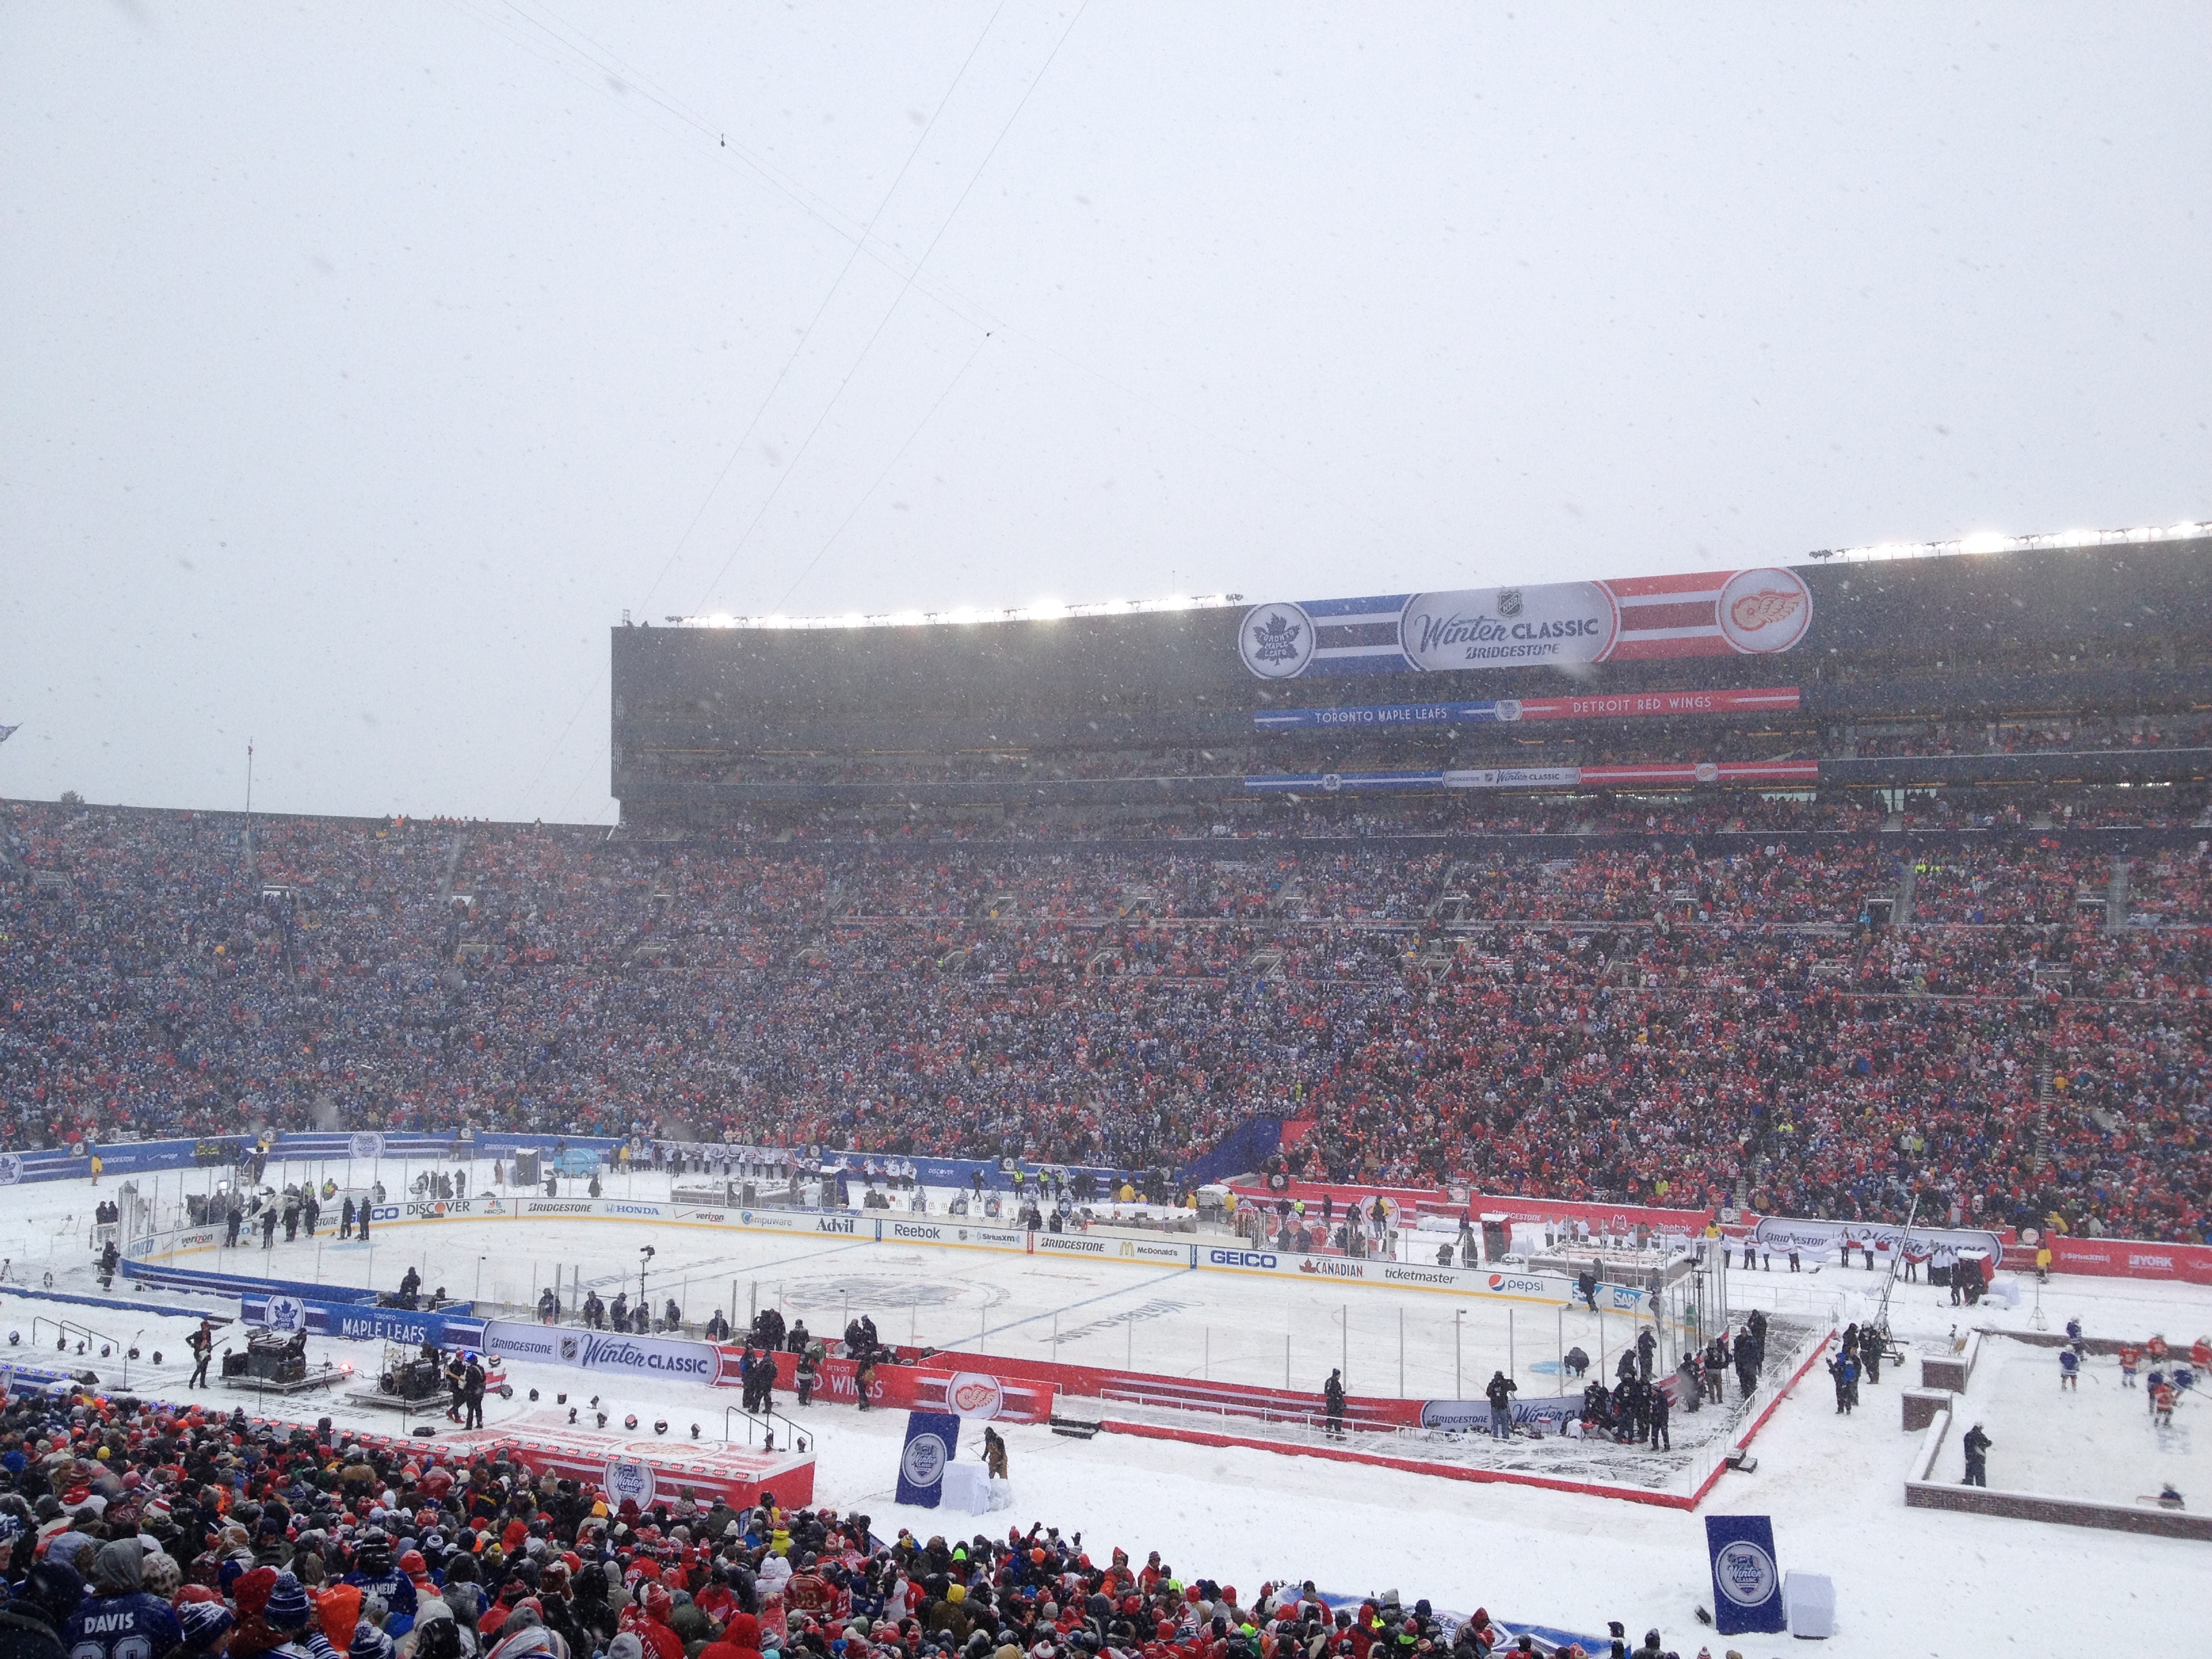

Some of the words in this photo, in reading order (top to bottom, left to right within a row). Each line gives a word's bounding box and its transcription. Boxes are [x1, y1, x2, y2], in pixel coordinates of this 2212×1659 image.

[1260, 630, 1294, 642] TORONTO
[1414, 612, 1510, 653] Winter
[1511, 619, 1599, 639] CLASSIC
[1265, 641, 1288, 649] MAPLE
[1465, 644, 1559, 659] BRIDGESTONE
[1265, 649, 1287, 657] LEAFS
[1574, 699, 1630, 712] DETROIT
[1638, 699, 1660, 710] RED
[1669, 696, 1712, 708] WINGS
[1315, 711, 1373, 723] TORONTO
[1378, 709, 1410, 721] MAPLE
[1416, 708, 1447, 719] LEAFS
[1496, 770, 1527, 784] Winter
[407, 1201, 470, 1215] DISCOVER
[528, 1203, 592, 1212] BRIDGESTONE
[616, 1205, 660, 1215] HONDA
[696, 1212, 724, 1223] verizon
[816, 1217, 855, 1233] Advil
[182, 1233, 213, 1244] verizon
[895, 1223, 941, 1240] Reebok
[1041, 1237, 1105, 1252] BRIDGESTONE
[1137, 1246, 1178, 1256] McDonald's
[1210, 1250, 1277, 1269] GEICO
[2139, 1256, 2173, 1267] YORK
[1316, 1261, 1363, 1277] CANADIAN
[1385, 1267, 1455, 1284] ticketmaster
[1508, 1279, 1543, 1292] pepsi
[1614, 1292, 1635, 1307] SAP
[343, 1318, 382, 1338] MAPLE
[388, 1323, 425, 1343] LEAFS
[491, 1337, 552, 1354] BRIDGESTONE
[581, 1333, 646, 1367] Winter
[647, 1354, 708, 1374] CLASSIC
[827, 1365, 850, 1373] DETROIT
[794, 1370, 823, 1391] RD
[1431, 1415, 1488, 1423] BRIDGESTONE
[912, 1452, 937, 1465] Winter
[613, 1471, 644, 1488] Winter
[1727, 1565, 1763, 1581] Winter
[85, 1612, 134, 1634] DAVIS
